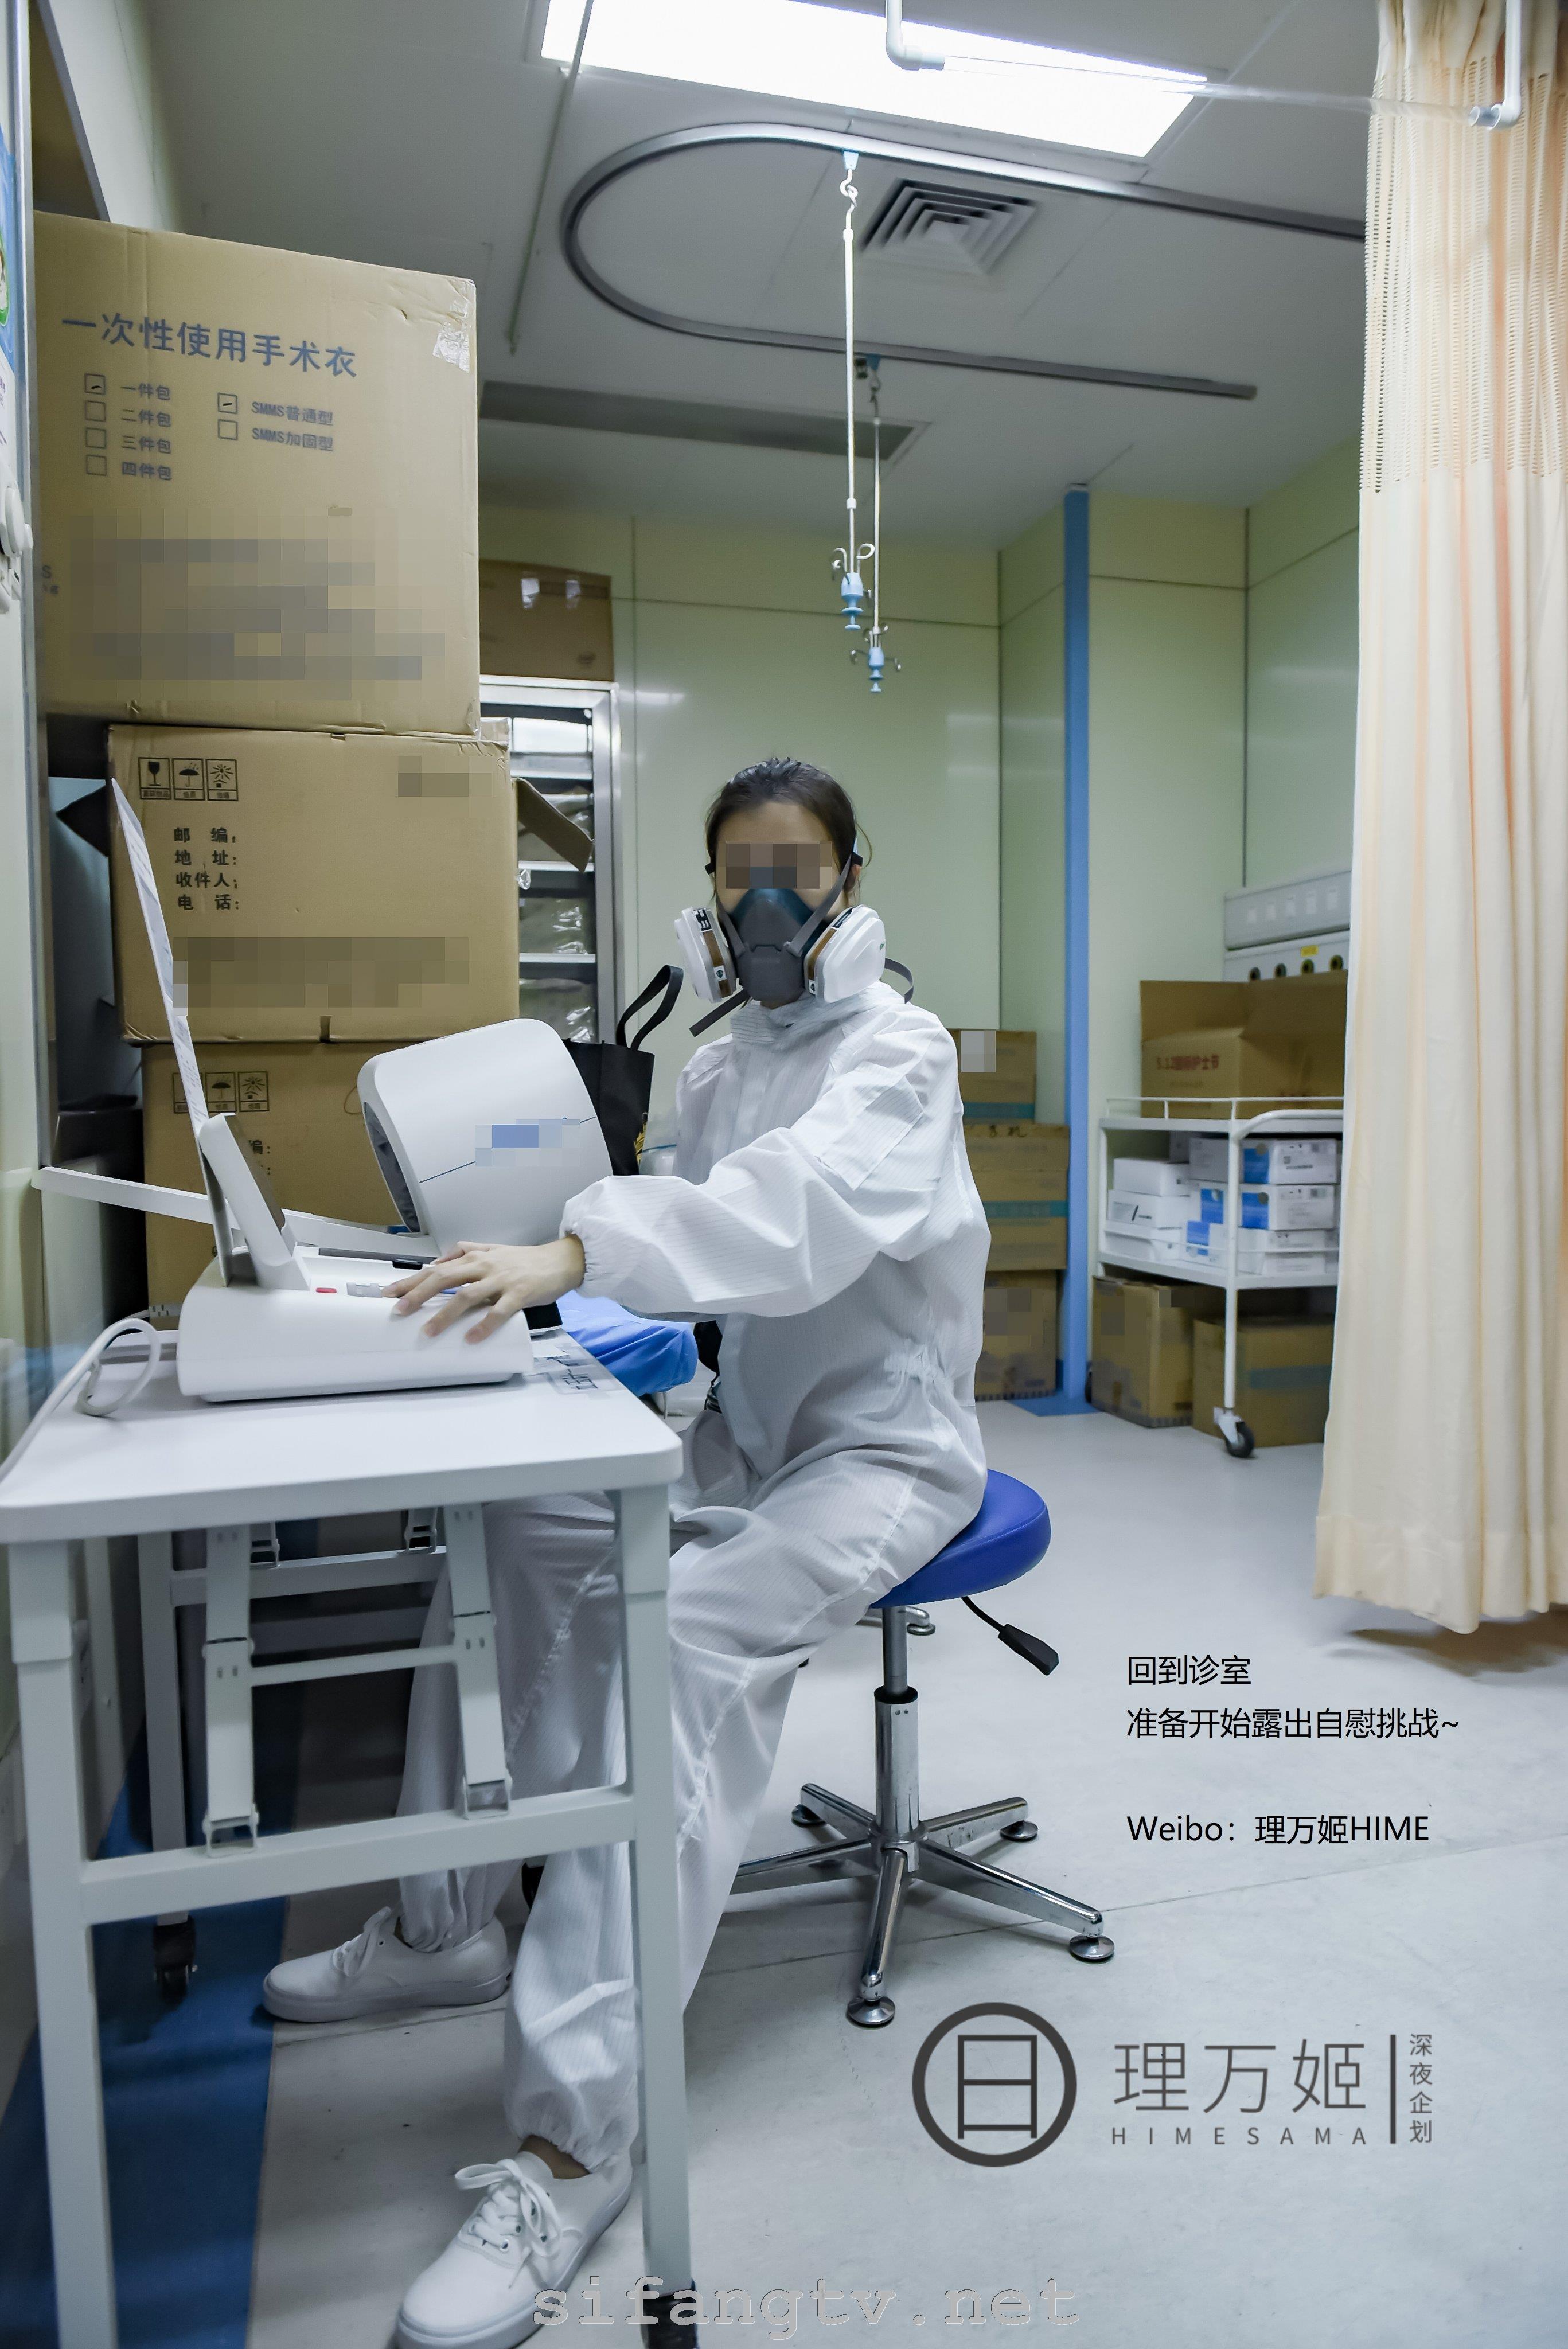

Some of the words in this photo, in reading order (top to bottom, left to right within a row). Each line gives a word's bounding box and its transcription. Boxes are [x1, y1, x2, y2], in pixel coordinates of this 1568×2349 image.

[61, 312, 357, 377] 一次性使用手术衣
[120, 382, 171, 401] 一件包
[120, 408, 171, 427] 二件包
[251, 401, 334, 426] SMMS普通型
[121, 434, 171, 454] 三件包
[251, 427, 334, 452] SMMS加固型
[122, 461, 172, 481] 四件包
